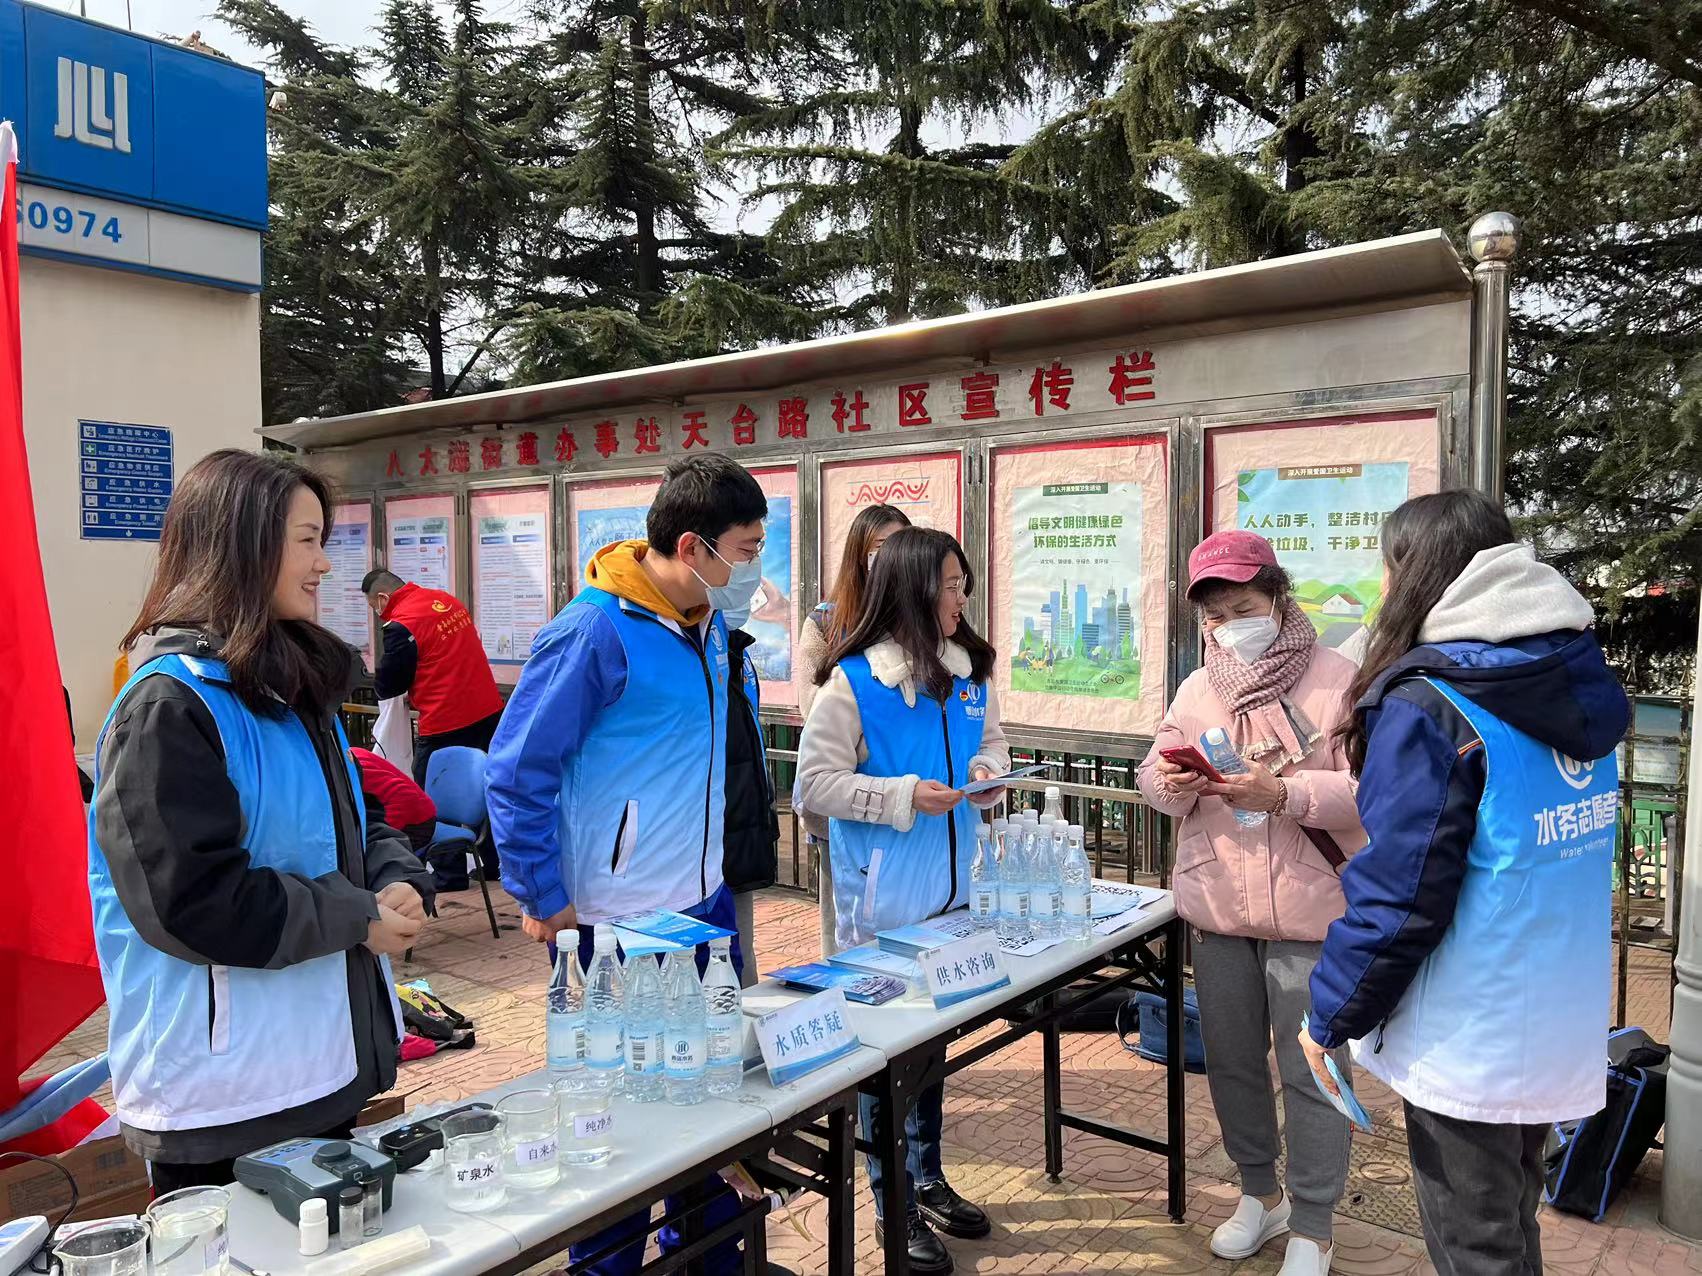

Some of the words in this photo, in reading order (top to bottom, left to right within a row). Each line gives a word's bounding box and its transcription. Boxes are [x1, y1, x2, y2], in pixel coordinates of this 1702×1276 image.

[1028, 515, 1124, 531] 倡导文明健康绿色
[1034, 534, 1118, 549] 环保的生活方式
[1533, 790, 1617, 846] 水务志愿者
[936, 951, 996, 987] 供水咨询
[775, 1010, 843, 1057] 水质答疑
[528, 1142, 559, 1161] 自来水
[457, 1164, 495, 1181] 矿泉水
